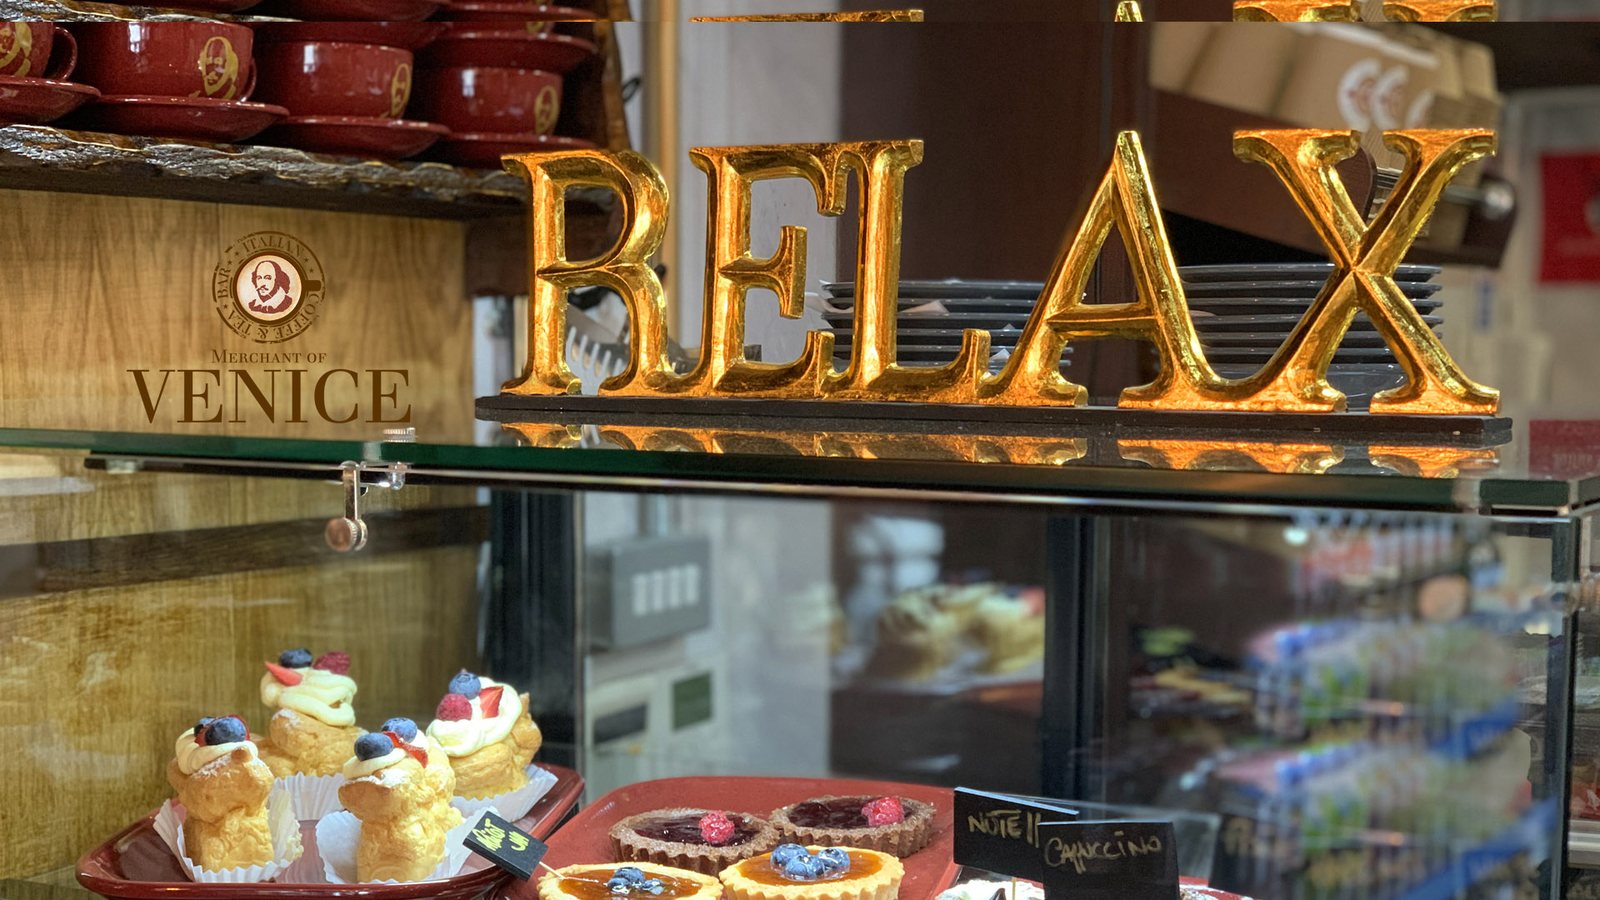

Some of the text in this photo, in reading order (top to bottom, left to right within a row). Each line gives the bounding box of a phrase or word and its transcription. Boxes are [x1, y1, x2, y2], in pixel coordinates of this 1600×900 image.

[217, 235, 320, 339] ITALIAN COFFEE & TEA BAR
[501, 130, 1500, 415] RELAX
[126, 368, 412, 424] VENICE
[211, 349, 327, 364] MERCHANT OF
